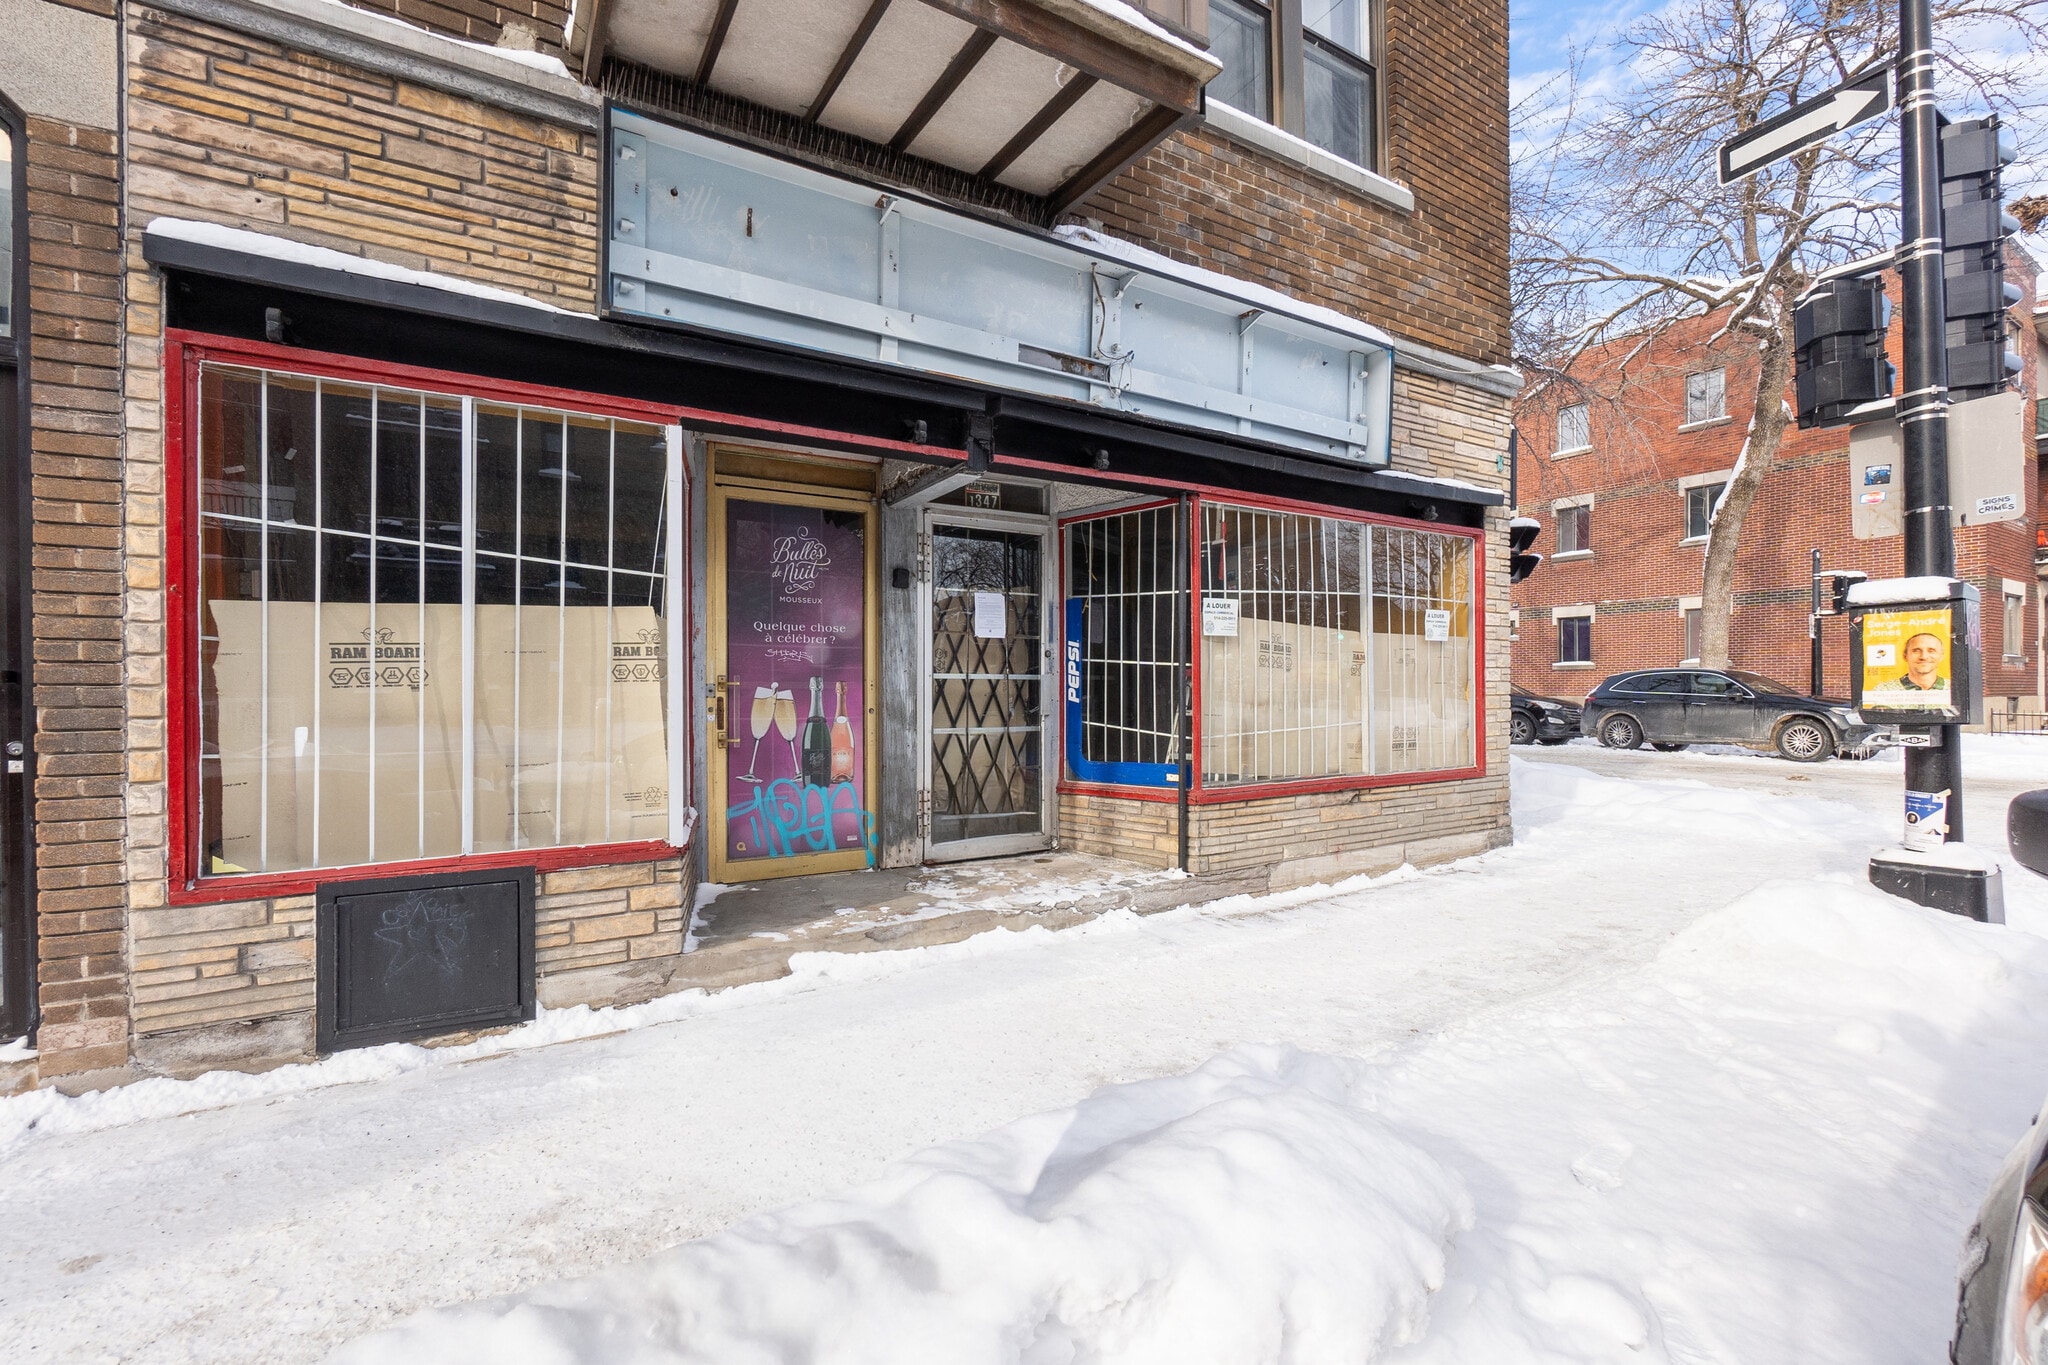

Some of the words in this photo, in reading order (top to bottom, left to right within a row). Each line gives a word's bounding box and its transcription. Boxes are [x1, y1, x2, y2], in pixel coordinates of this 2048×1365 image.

[970, 494, 998, 509] 1347
[1982, 496, 2011, 505] SIGNS
[1978, 503, 2015, 514] CRIMES
[770, 535, 828, 563] Bulles
[771, 564, 782, 578] de
[782, 559, 830, 583] Nuit
[779, 596, 823, 604] MOUSSEUX
[753, 621, 806, 633] Quelque
[810, 622, 846, 633] chose
[1867, 616, 1947, 630] Serge-André
[764, 632, 773, 643] à
[1867, 629, 1902, 638] Jones
[330, 646, 368, 659] RAM
[612, 646, 641, 657] RAM
[1067, 640, 1080, 704] PEPSI
